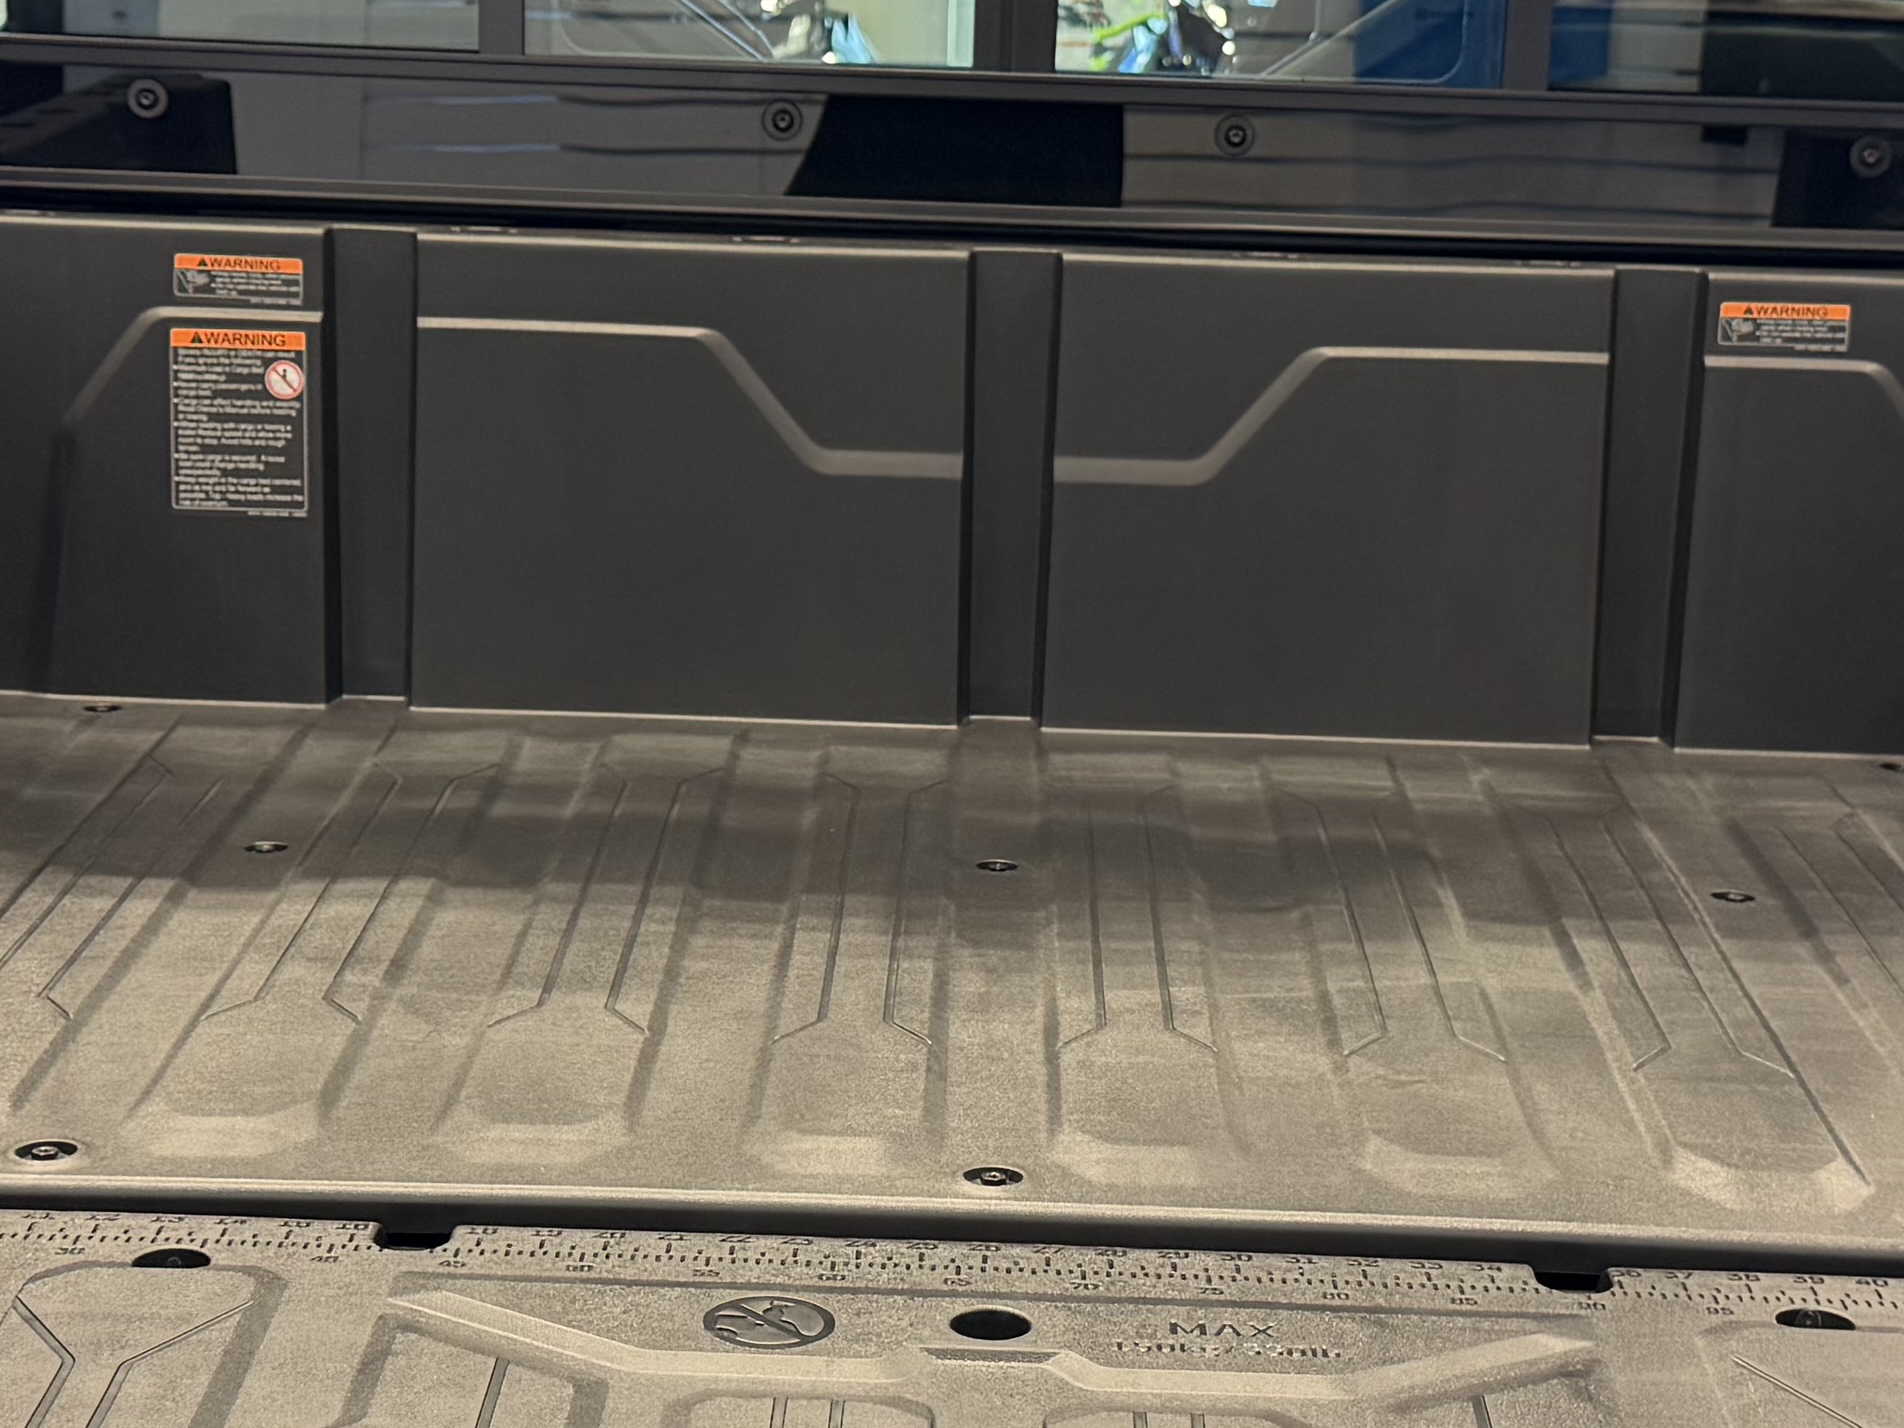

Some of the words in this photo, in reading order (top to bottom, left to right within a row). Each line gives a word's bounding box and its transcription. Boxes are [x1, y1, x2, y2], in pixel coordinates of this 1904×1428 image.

[209, 257, 280, 271] WARNING
[1756, 306, 1828, 317] WARNING
[204, 332, 286, 347] WARNING
[1168, 1321, 1275, 1338] MAX
